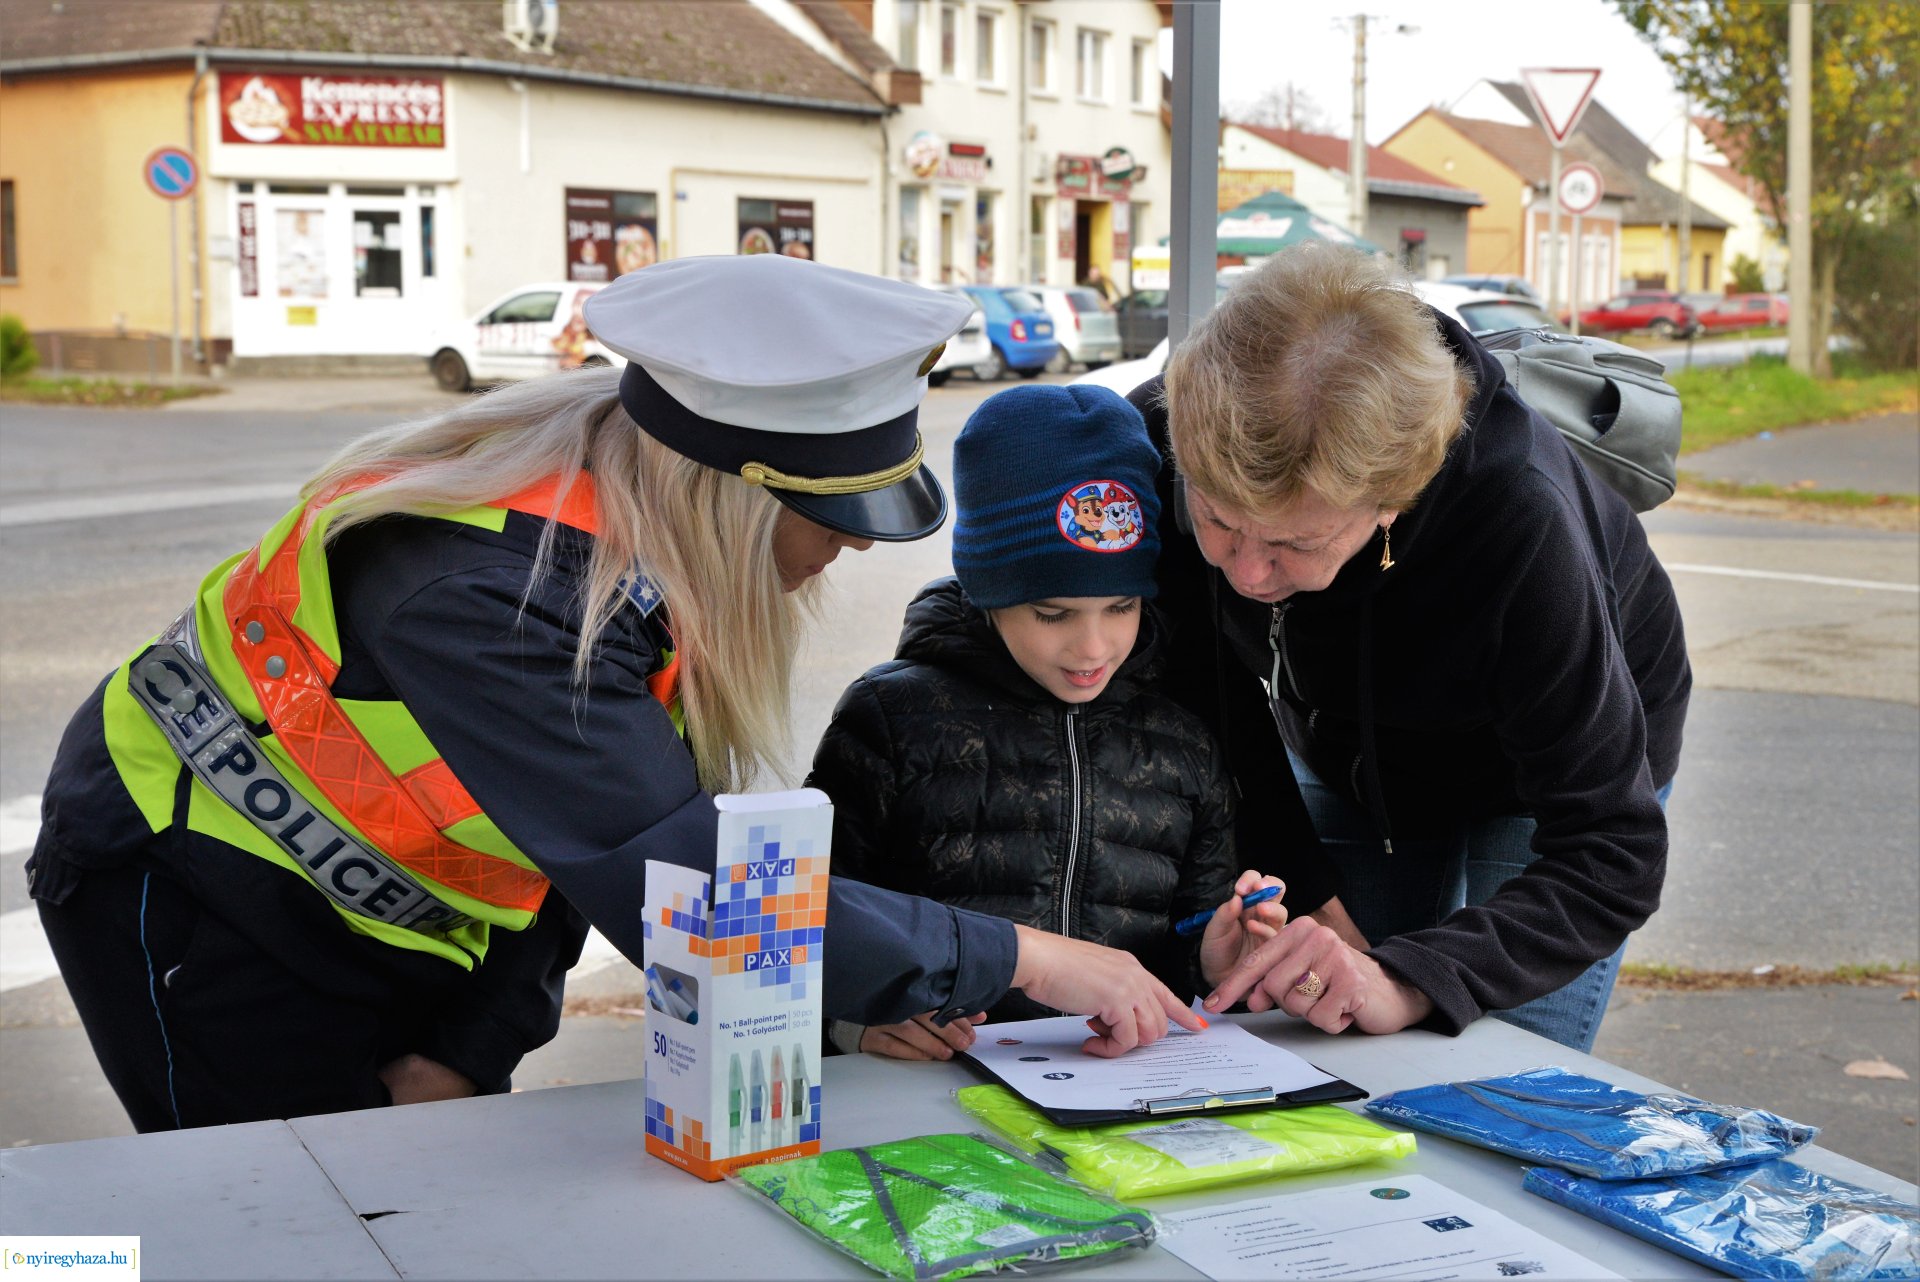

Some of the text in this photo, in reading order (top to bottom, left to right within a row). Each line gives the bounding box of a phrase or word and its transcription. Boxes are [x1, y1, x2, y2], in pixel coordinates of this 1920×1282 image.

[303, 102, 441, 126] EXPRESSZ
[208, 740, 410, 916] POLICE
[748, 860, 793, 879] PAX
[747, 950, 789, 970] PAX
[719, 1022, 731, 1030] No.
[738, 1014, 772, 1027] Ball-point
[773, 1013, 787, 1022] pen
[752, 1023, 787, 1035] Golyóstoll
[654, 1030, 667, 1057] 50
